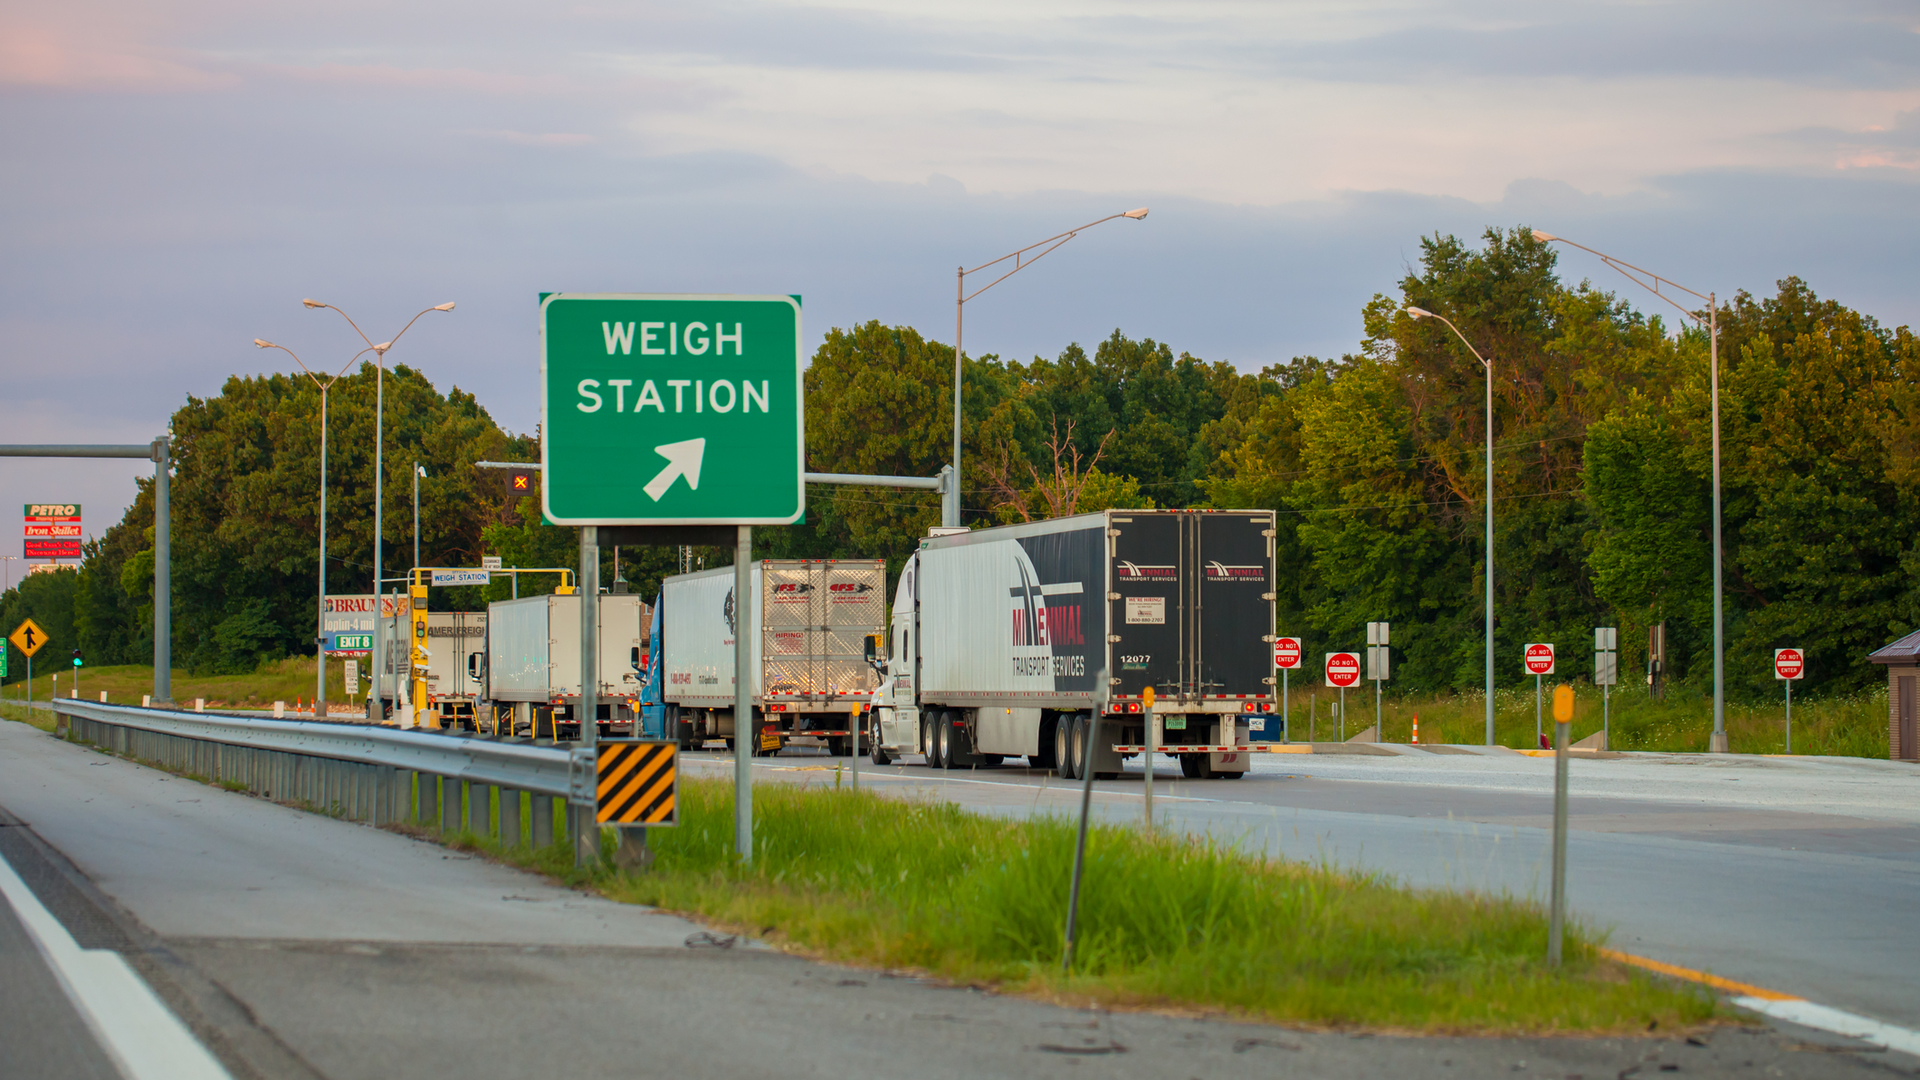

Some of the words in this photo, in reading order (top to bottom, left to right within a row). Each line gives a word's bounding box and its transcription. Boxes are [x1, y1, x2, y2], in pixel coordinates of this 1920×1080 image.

[602, 321, 742, 355] WEIGH
[576, 378, 769, 413] STATION
[30, 504, 76, 516] PETRO
[26, 526, 48, 535] Iron
[50, 526, 79, 535] Skillet
[458, 573, 487, 581] STATION
[340, 636, 361, 648] EXIT
[362, 636, 370, 648] 8
[1120, 655, 1151, 663] 12077
[1013, 656, 1049, 676] TRANSPORT
[1053, 655, 1085, 676] SERVICES
